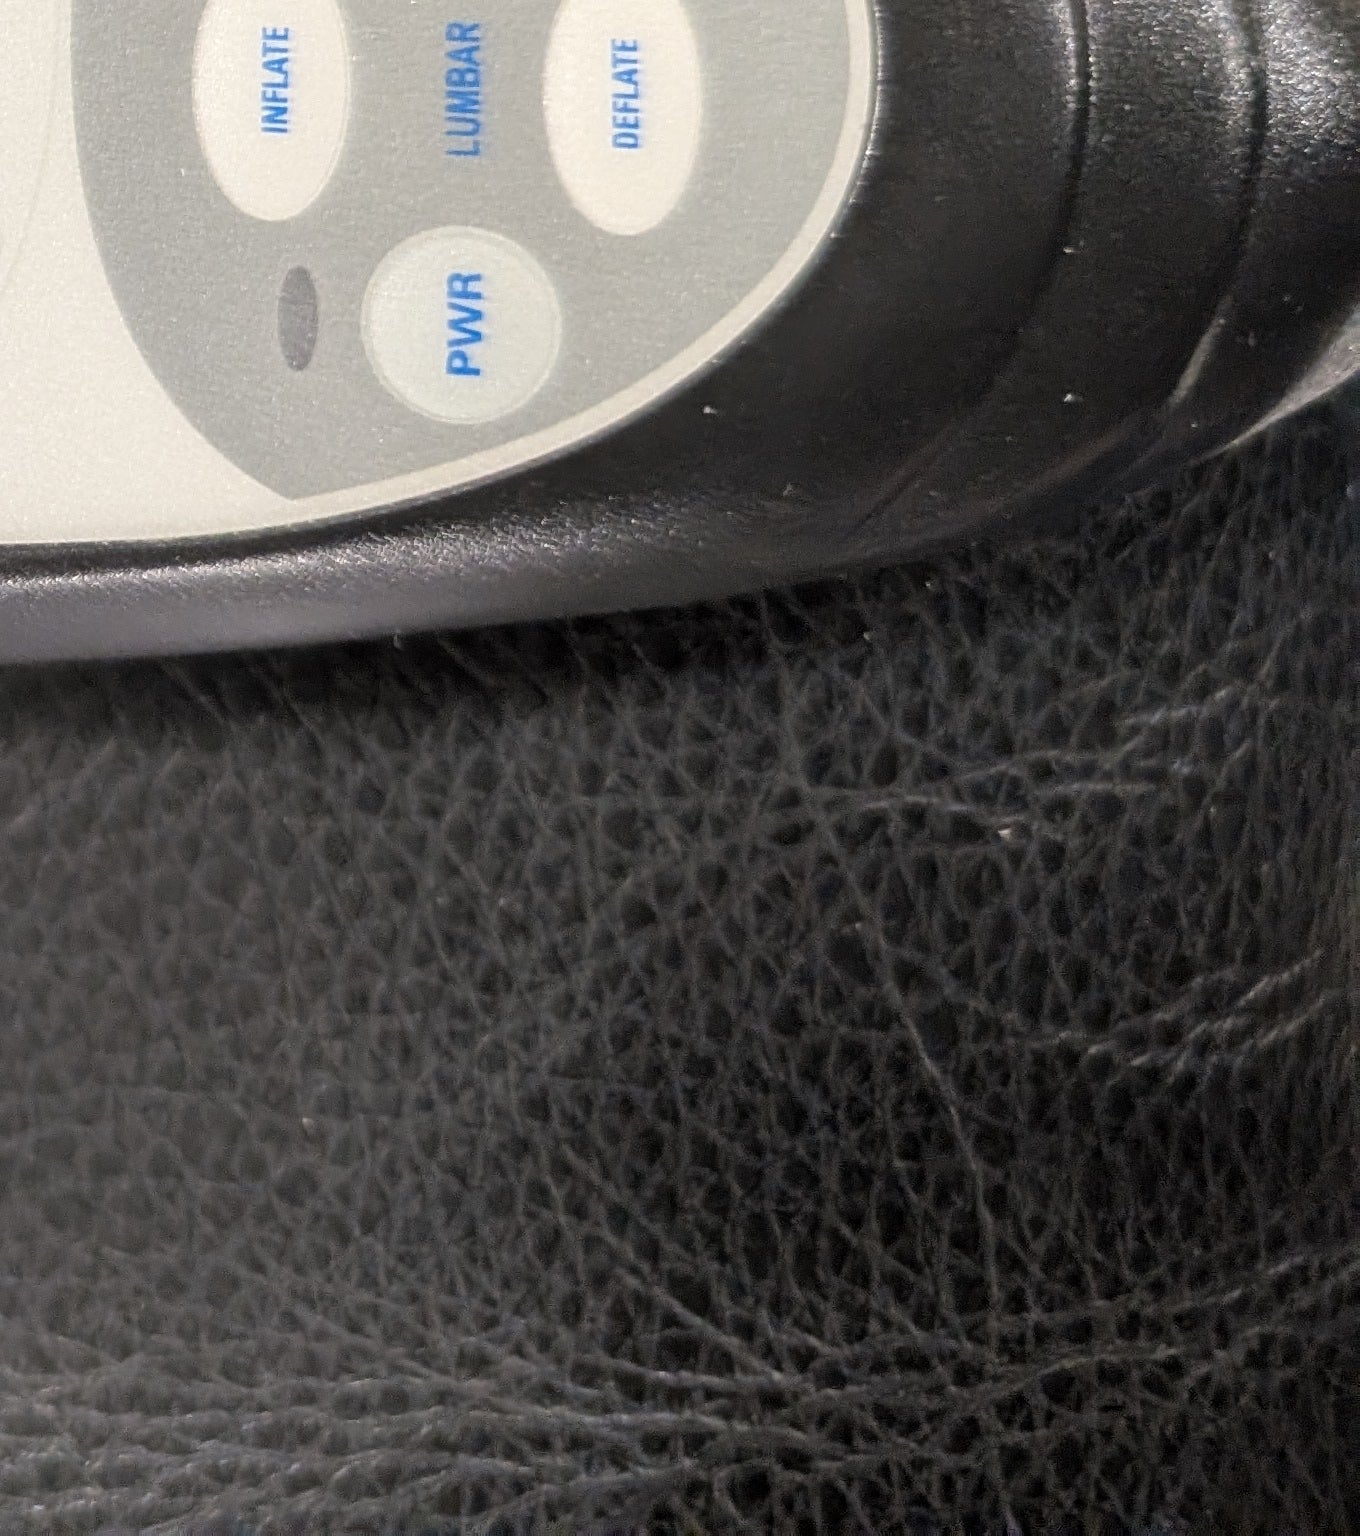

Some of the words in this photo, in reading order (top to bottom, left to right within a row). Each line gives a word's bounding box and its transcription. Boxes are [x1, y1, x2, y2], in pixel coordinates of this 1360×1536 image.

[262, 27, 290, 134] INFLATE
[445, 20, 481, 157] LUMBAR
[611, 38, 639, 150] DEFLATE
[446, 274, 485, 377] PWR
